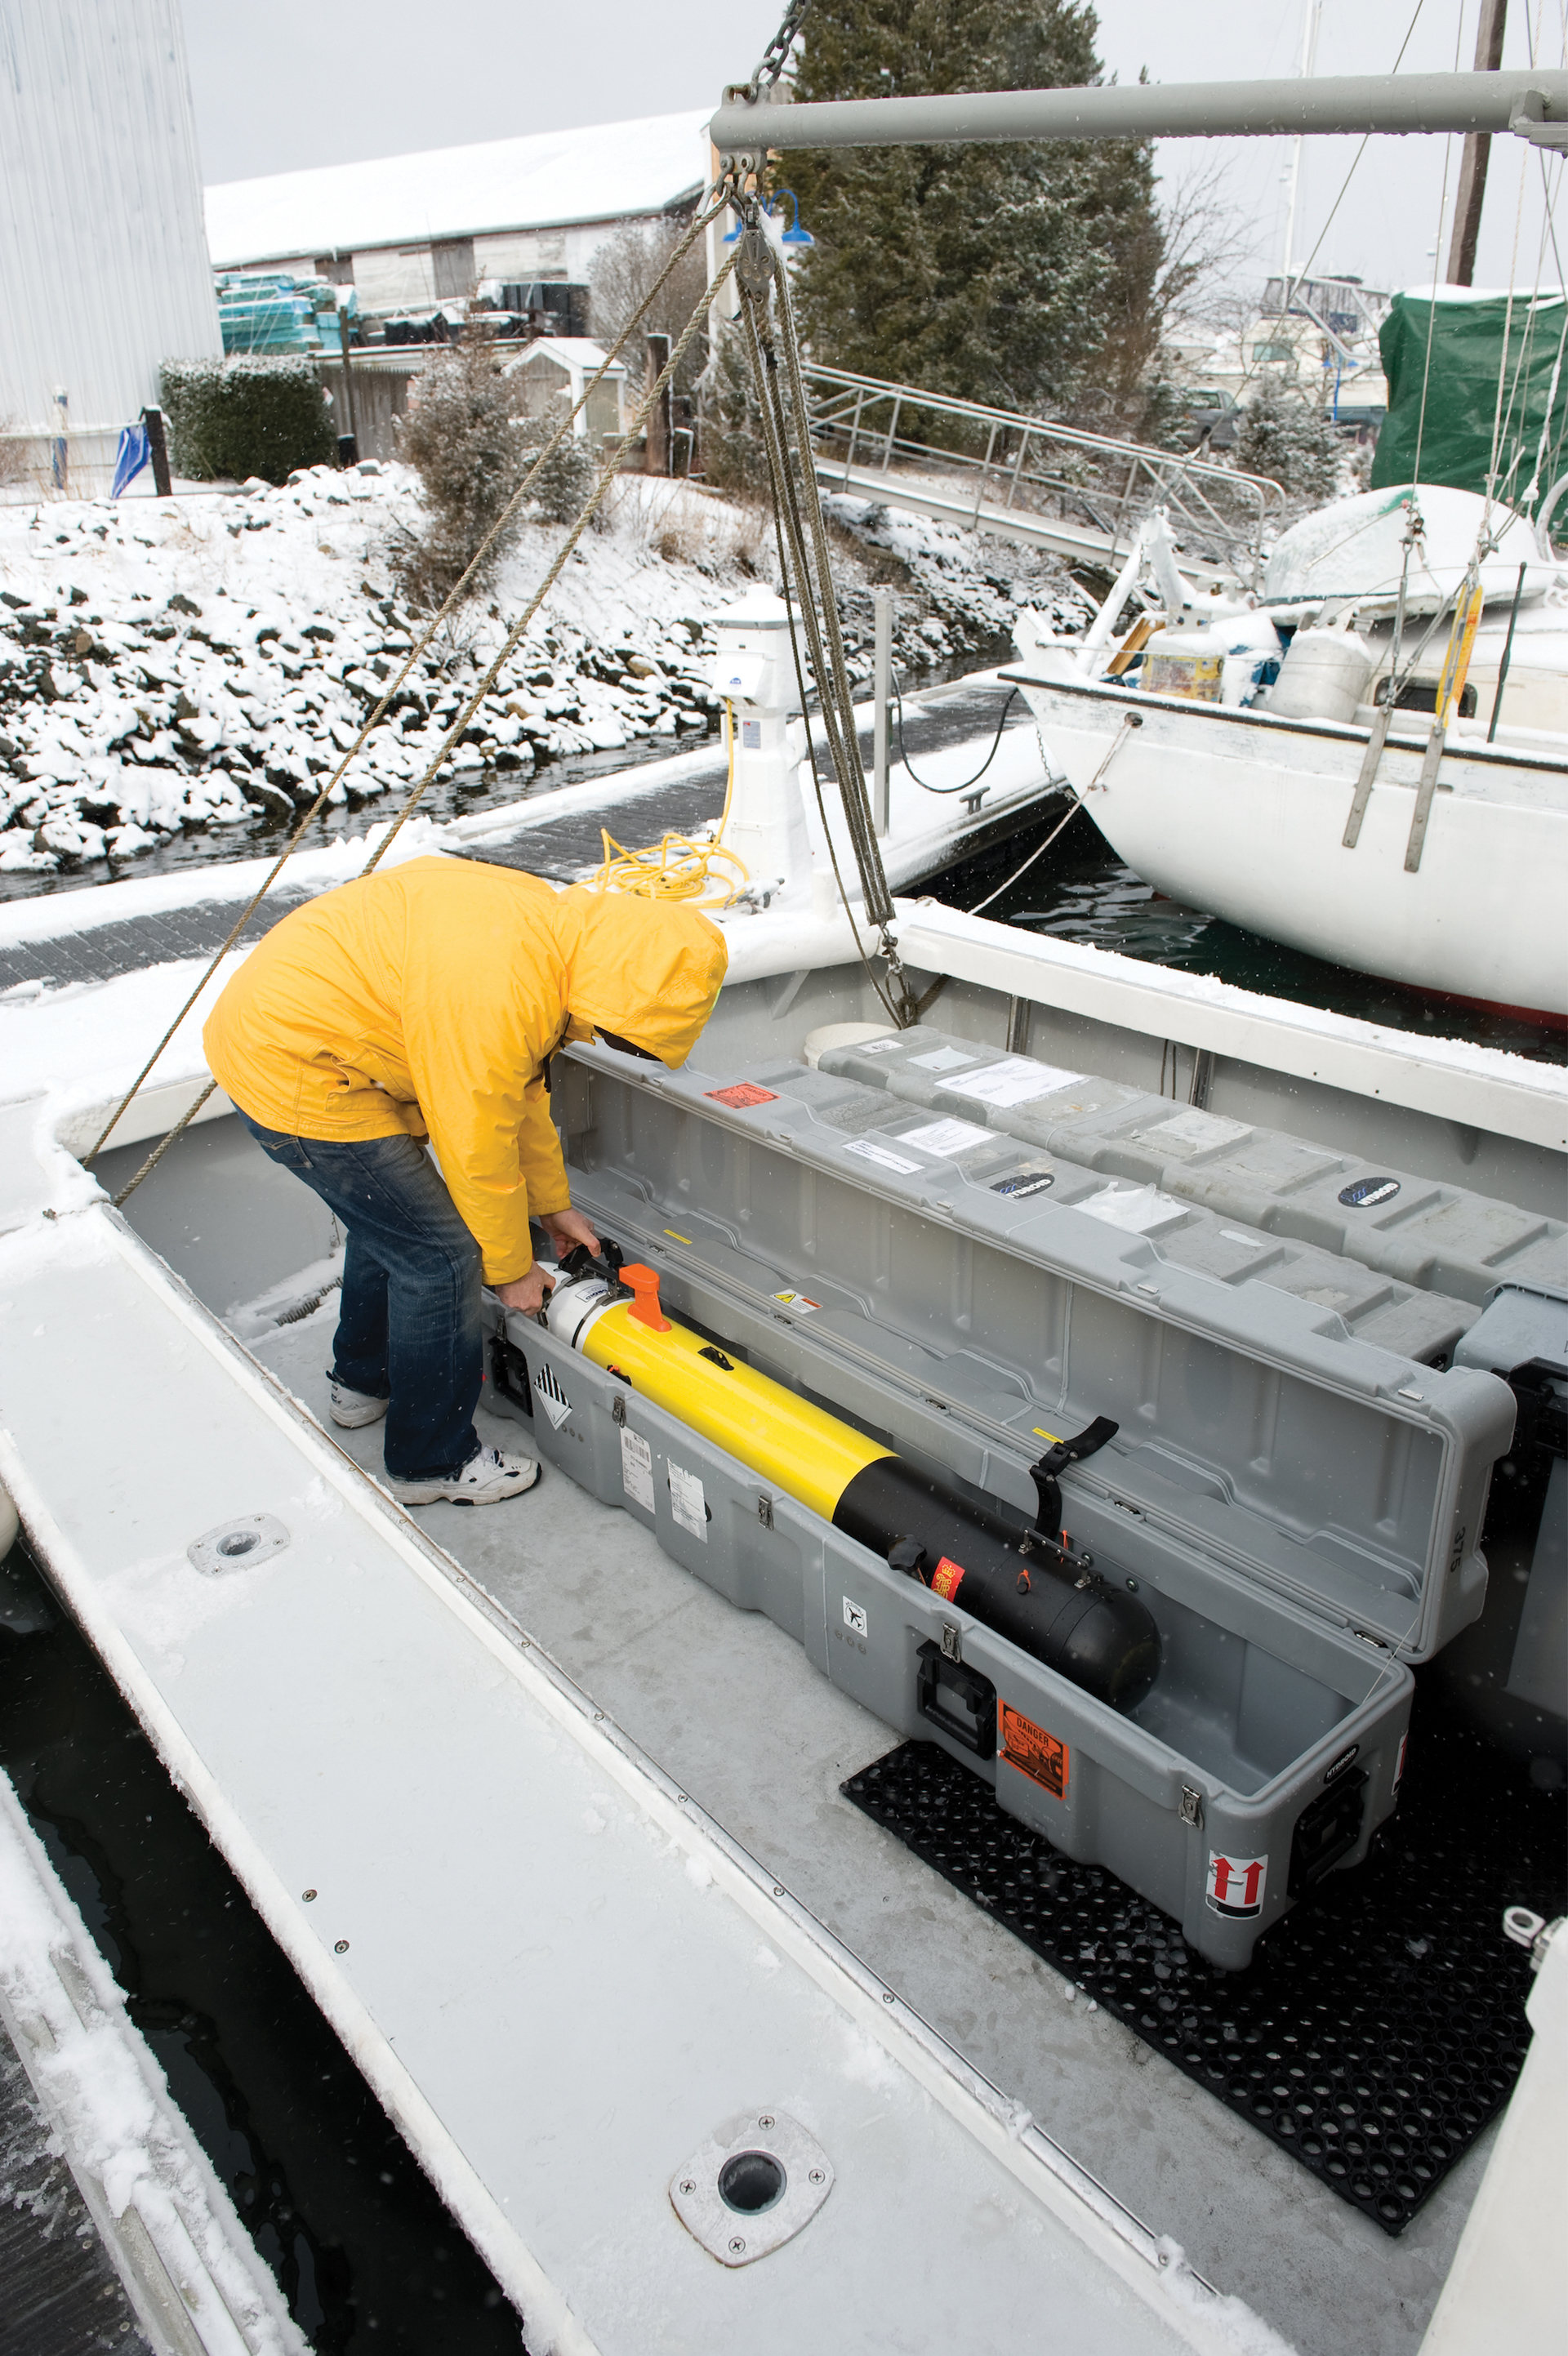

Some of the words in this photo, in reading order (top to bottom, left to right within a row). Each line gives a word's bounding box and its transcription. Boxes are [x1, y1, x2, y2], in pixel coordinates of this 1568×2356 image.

[1356, 1182, 1399, 1206] HYDROID
[1450, 1526, 1466, 1573] 375
[1017, 1717, 1049, 1747] DANGER
[1326, 1747, 1356, 1779] HYDROID
